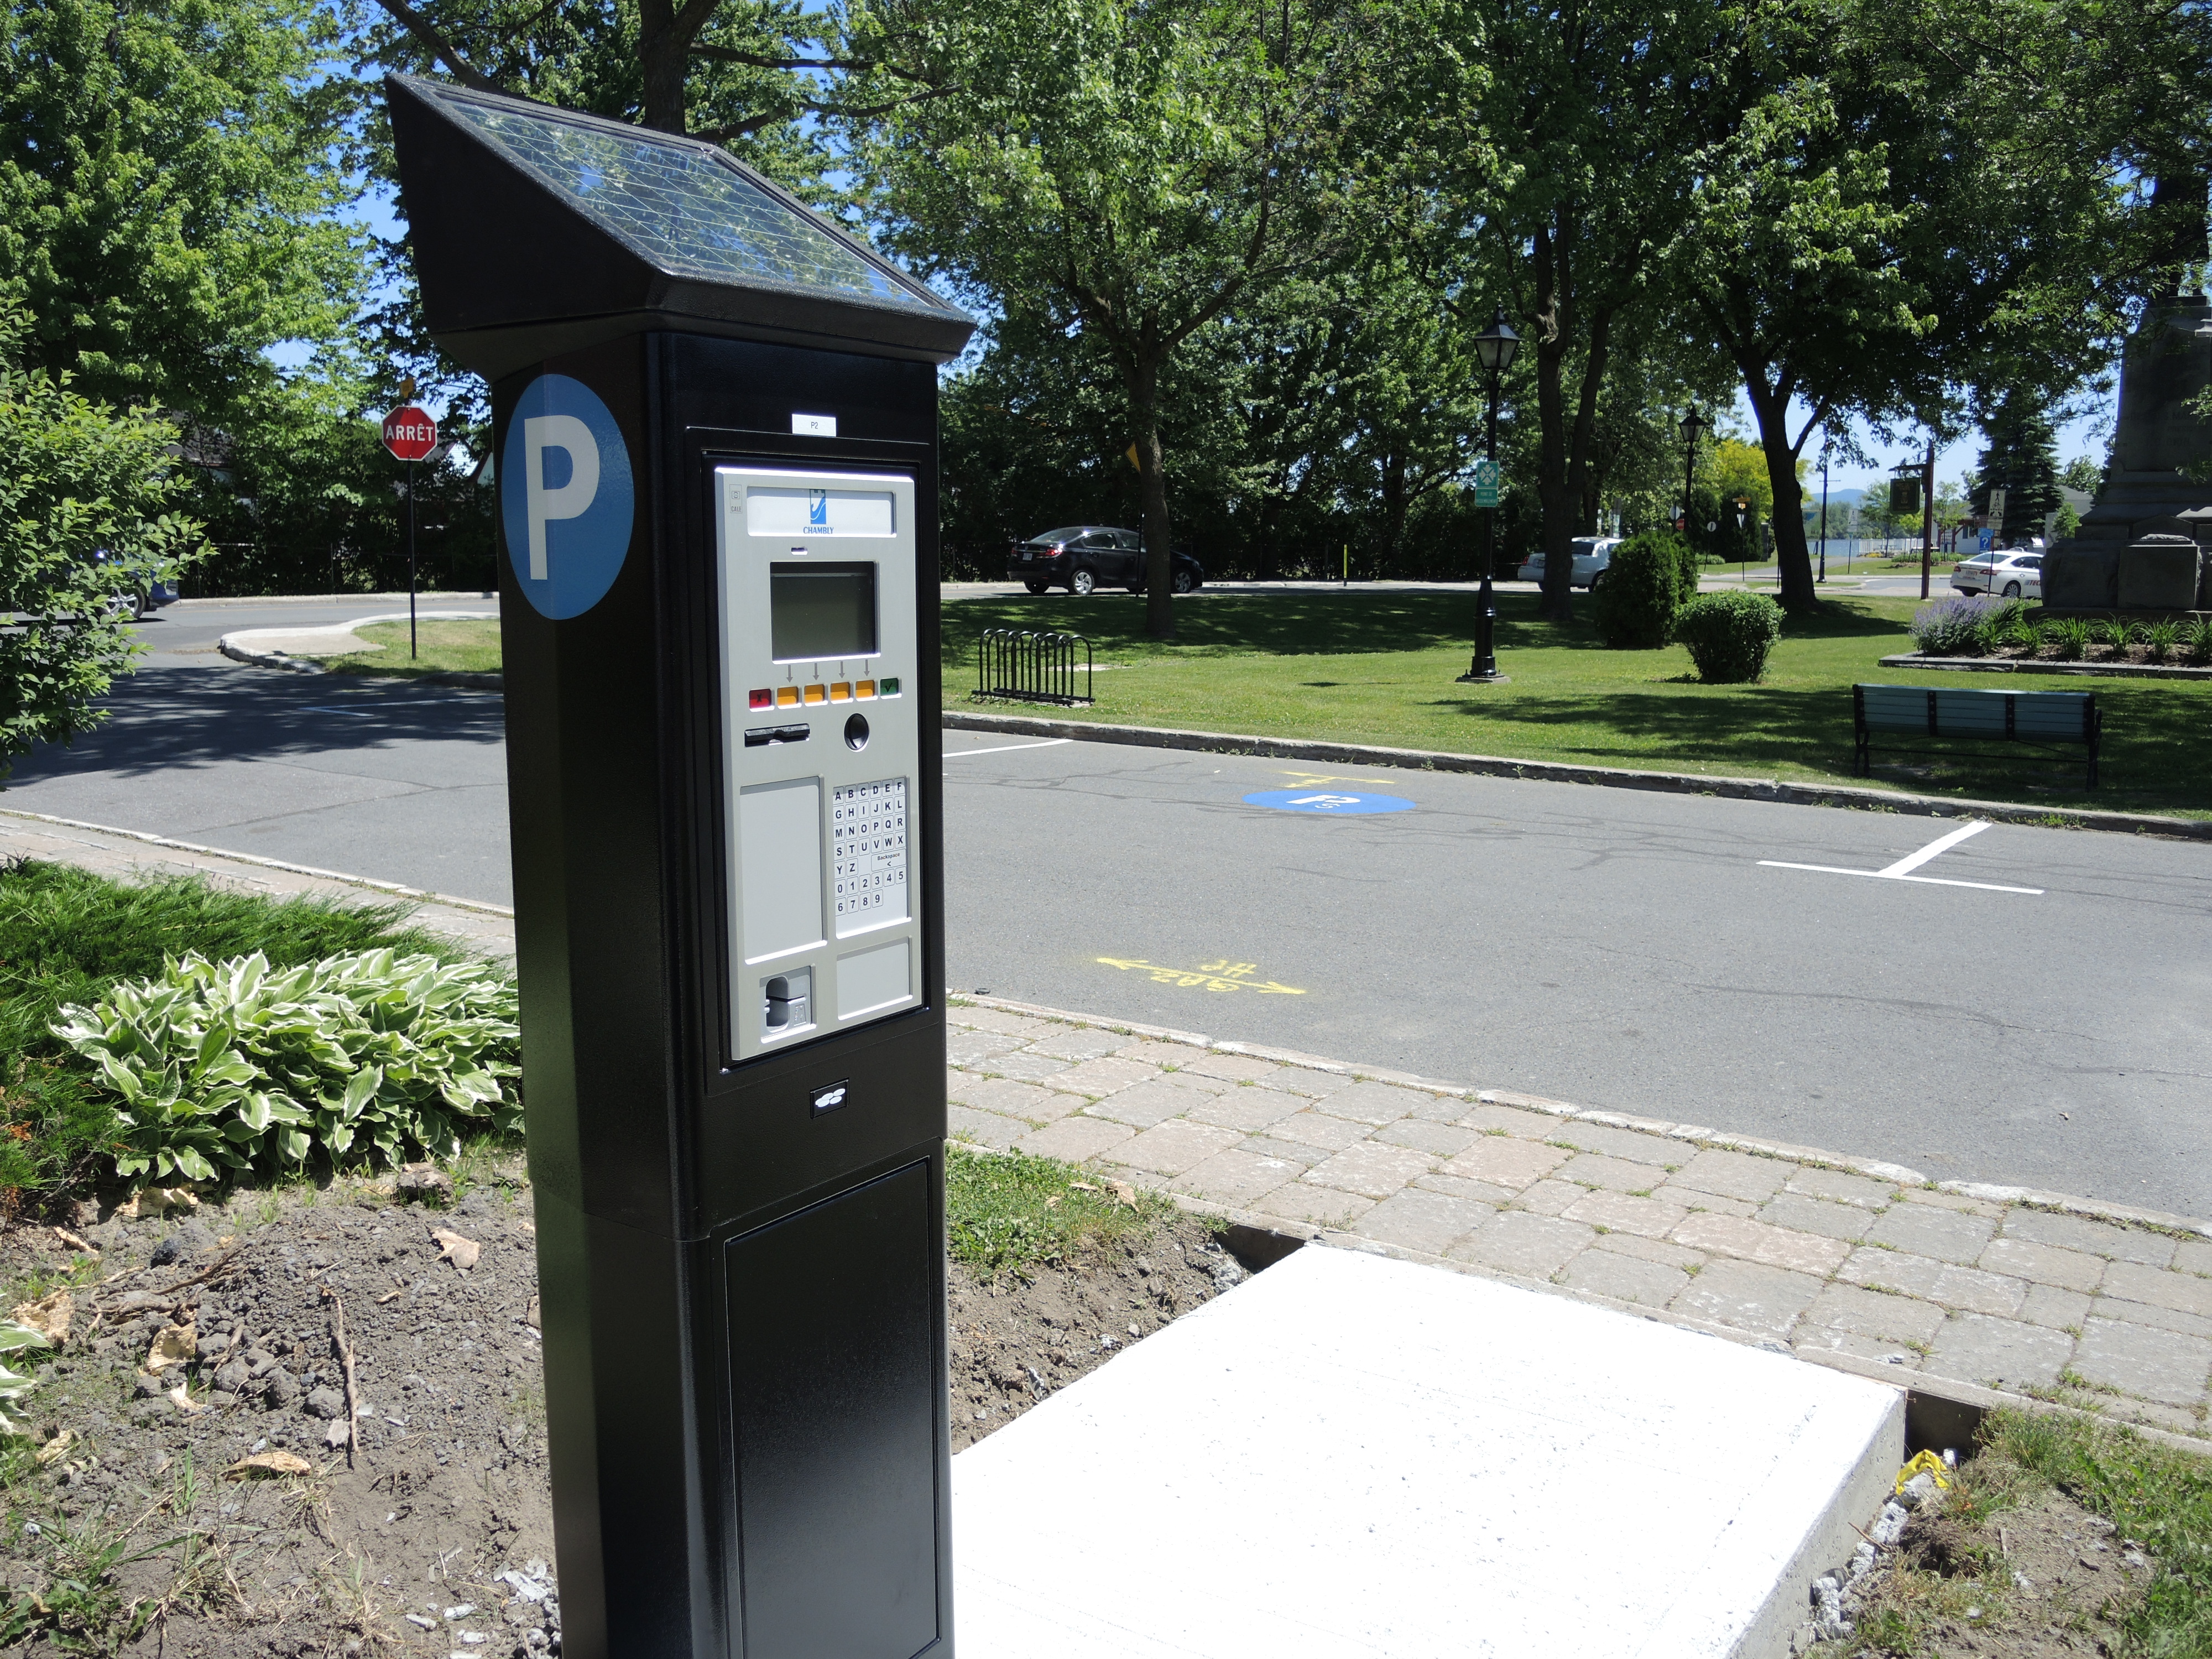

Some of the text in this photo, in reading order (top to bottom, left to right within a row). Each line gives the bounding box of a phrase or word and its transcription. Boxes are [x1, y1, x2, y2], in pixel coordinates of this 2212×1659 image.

[385, 423, 434, 442] ARRÊT
[524, 415, 600, 580] P
[836, 782, 901, 800] A B C D E F
[836, 810, 842, 818] G
[848, 808, 854, 817] H
[874, 804, 878, 812] J
[885, 802, 891, 810] K
[898, 800, 902, 808] L
[836, 818, 902, 838] M N O P Q R
[837, 836, 903, 855] S T U V W X
[837, 863, 855, 874] Y Z
[838, 884, 842, 893] 0
[851, 881, 854, 890] 1
[863, 879, 867, 888] 2
[875, 877, 879, 885] 3
[887, 874, 891, 882] 4
[838, 894, 880, 911] 6 7 8 9
